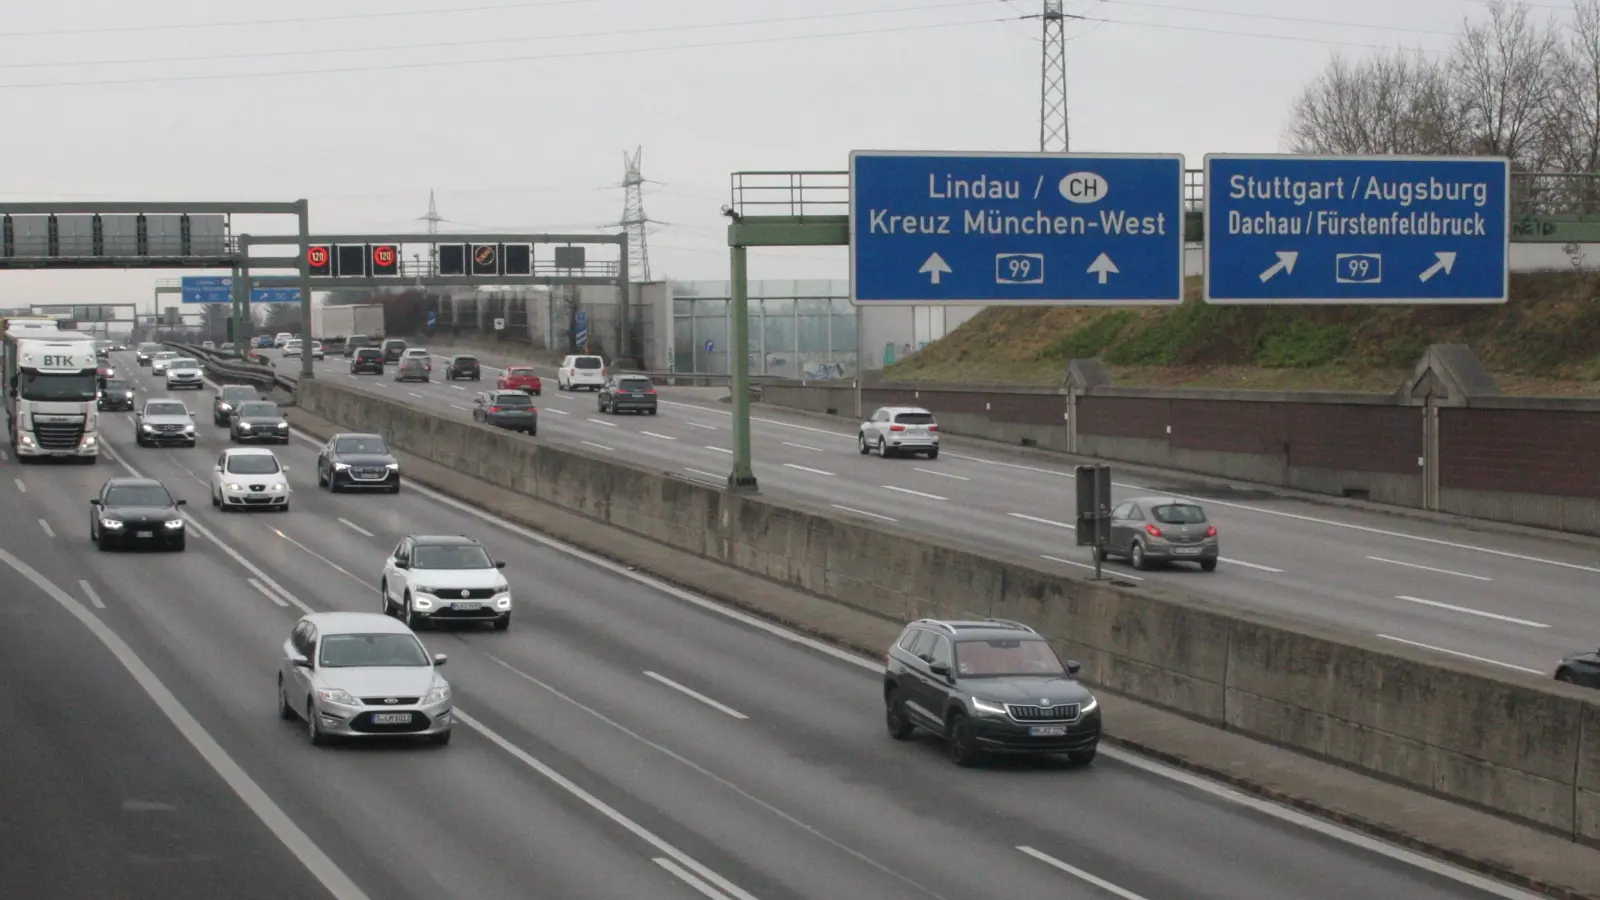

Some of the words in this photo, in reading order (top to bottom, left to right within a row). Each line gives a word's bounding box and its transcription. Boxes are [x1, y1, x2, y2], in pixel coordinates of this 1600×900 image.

[929, 174, 1020, 199] Lindau
[1069, 177, 1098, 198] CH
[870, 208, 950, 234] Kreuz
[964, 209, 1166, 236] München-West
[312, 252, 324, 261] 120
[380, 251, 391, 261] 120
[1008, 259, 1031, 278] 99
[1348, 259, 1369, 278] 99
[43, 355, 74, 367] BTK
